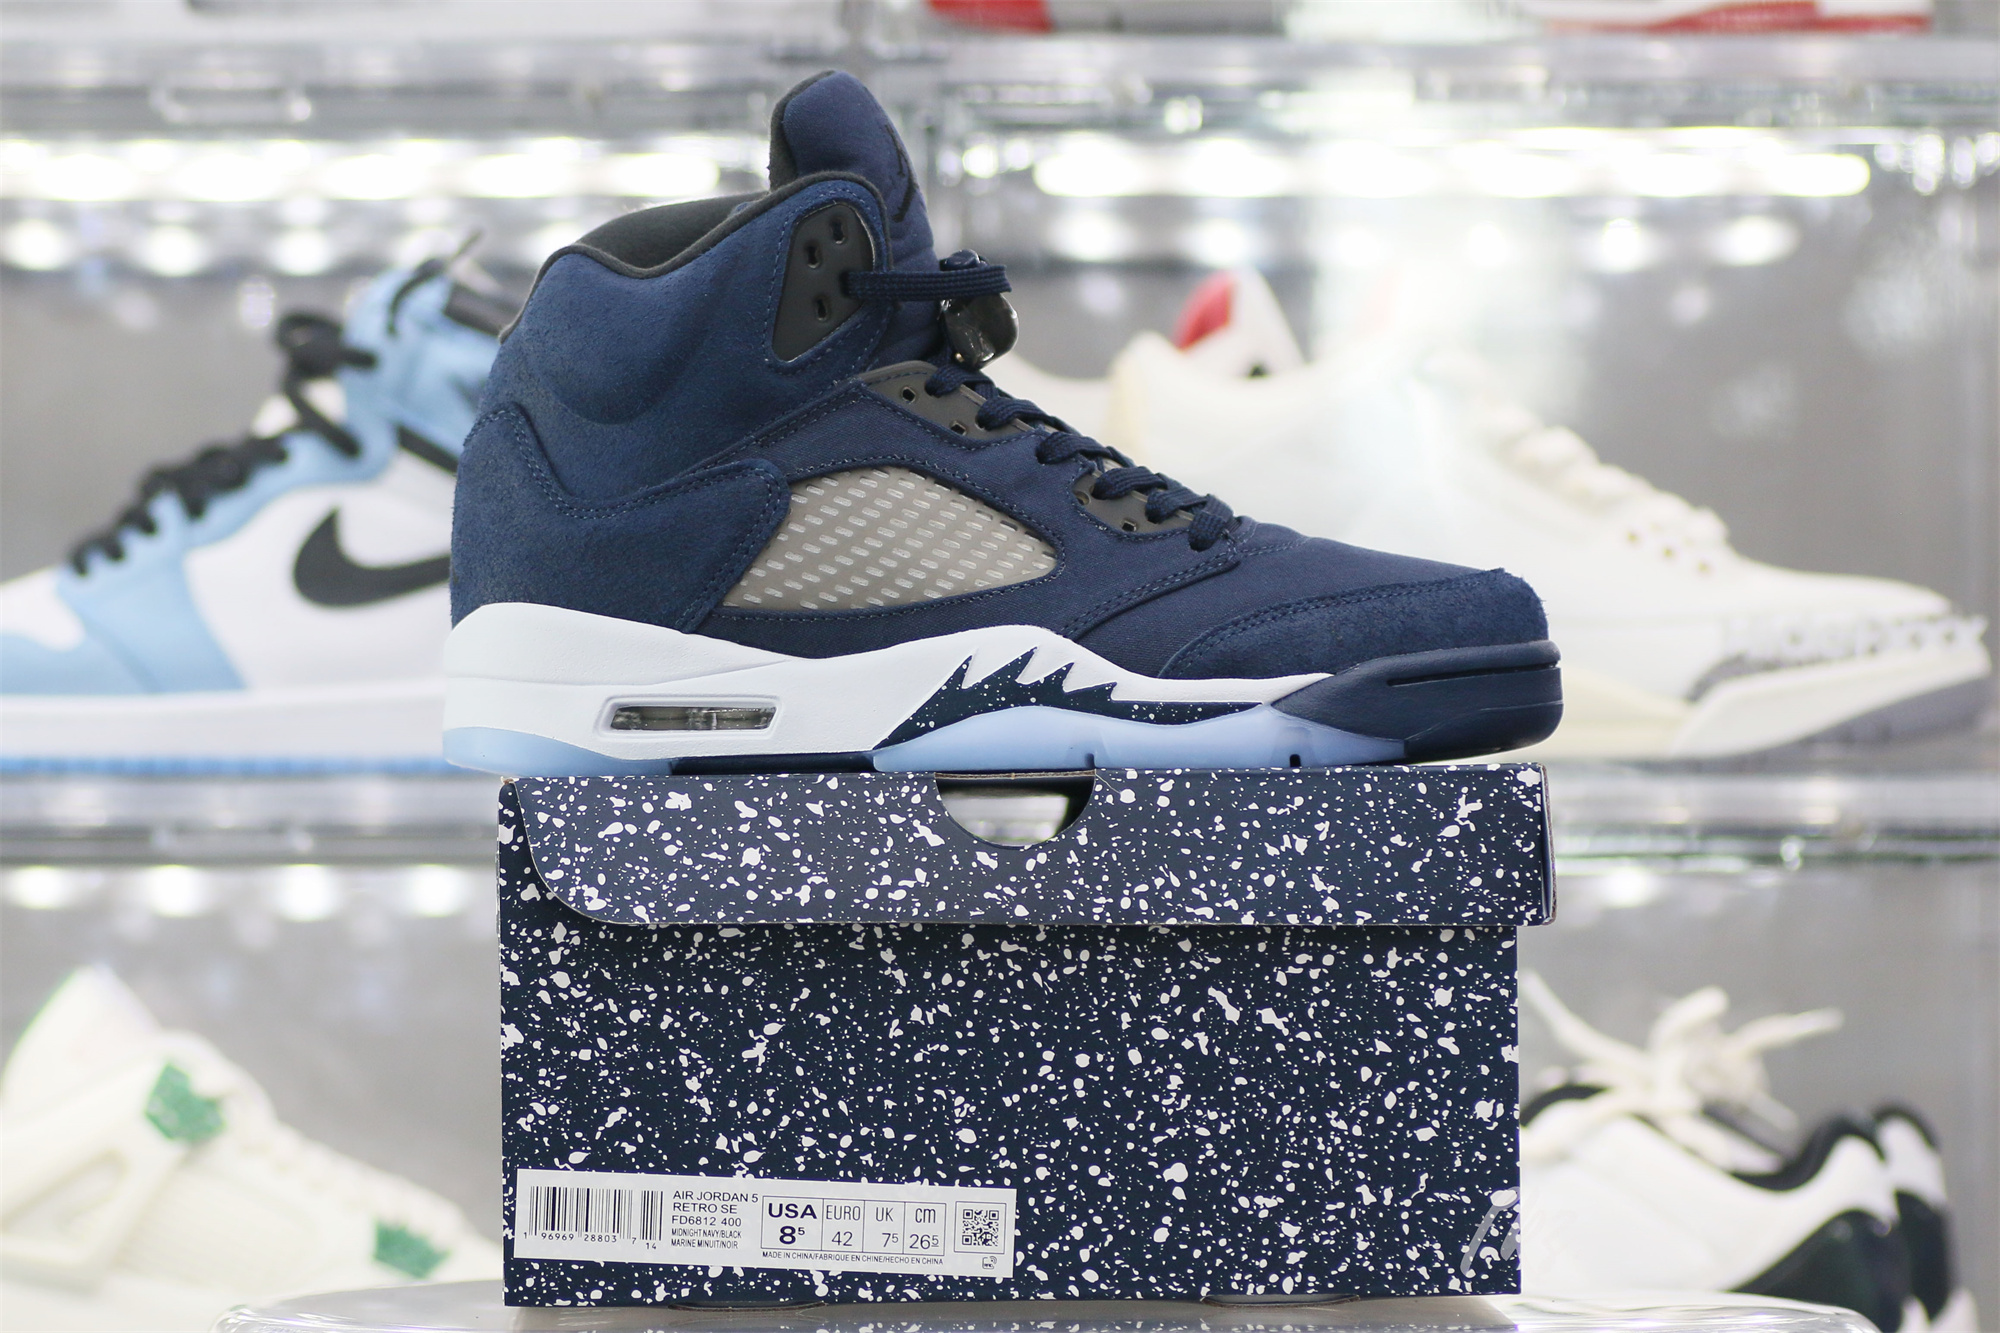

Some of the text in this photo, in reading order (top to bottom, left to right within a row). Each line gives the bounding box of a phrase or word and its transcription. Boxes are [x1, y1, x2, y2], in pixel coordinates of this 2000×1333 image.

[673, 1190, 759, 1203] AIR JORDAN 5
[673, 1202, 738, 1214] RETRO SE
[768, 1203, 818, 1219] USA
[826, 1205, 861, 1221] EURO
[875, 1207, 894, 1222] UK
[671, 1215, 742, 1227] FD6812 400
[541, 1232, 575, 1241] 96969
[583, 1234, 617, 1243] 28803
[631, 1237, 637, 1245] 7
[671, 1228, 742, 1239] MIDNIGHT NAVY/BLACK
[831, 1231, 853, 1247] 42
[646, 1242, 657, 1250] 14
[671, 1238, 739, 1249] MARINE MINUIT/NOIR
[762, 1251, 782, 1259] MADE
[791, 1252, 850, 1261] CHINA/FABRIQUE
[861, 1255, 910, 1264] CHINE/HECHO
[921, 1257, 944, 1265] CHINA
